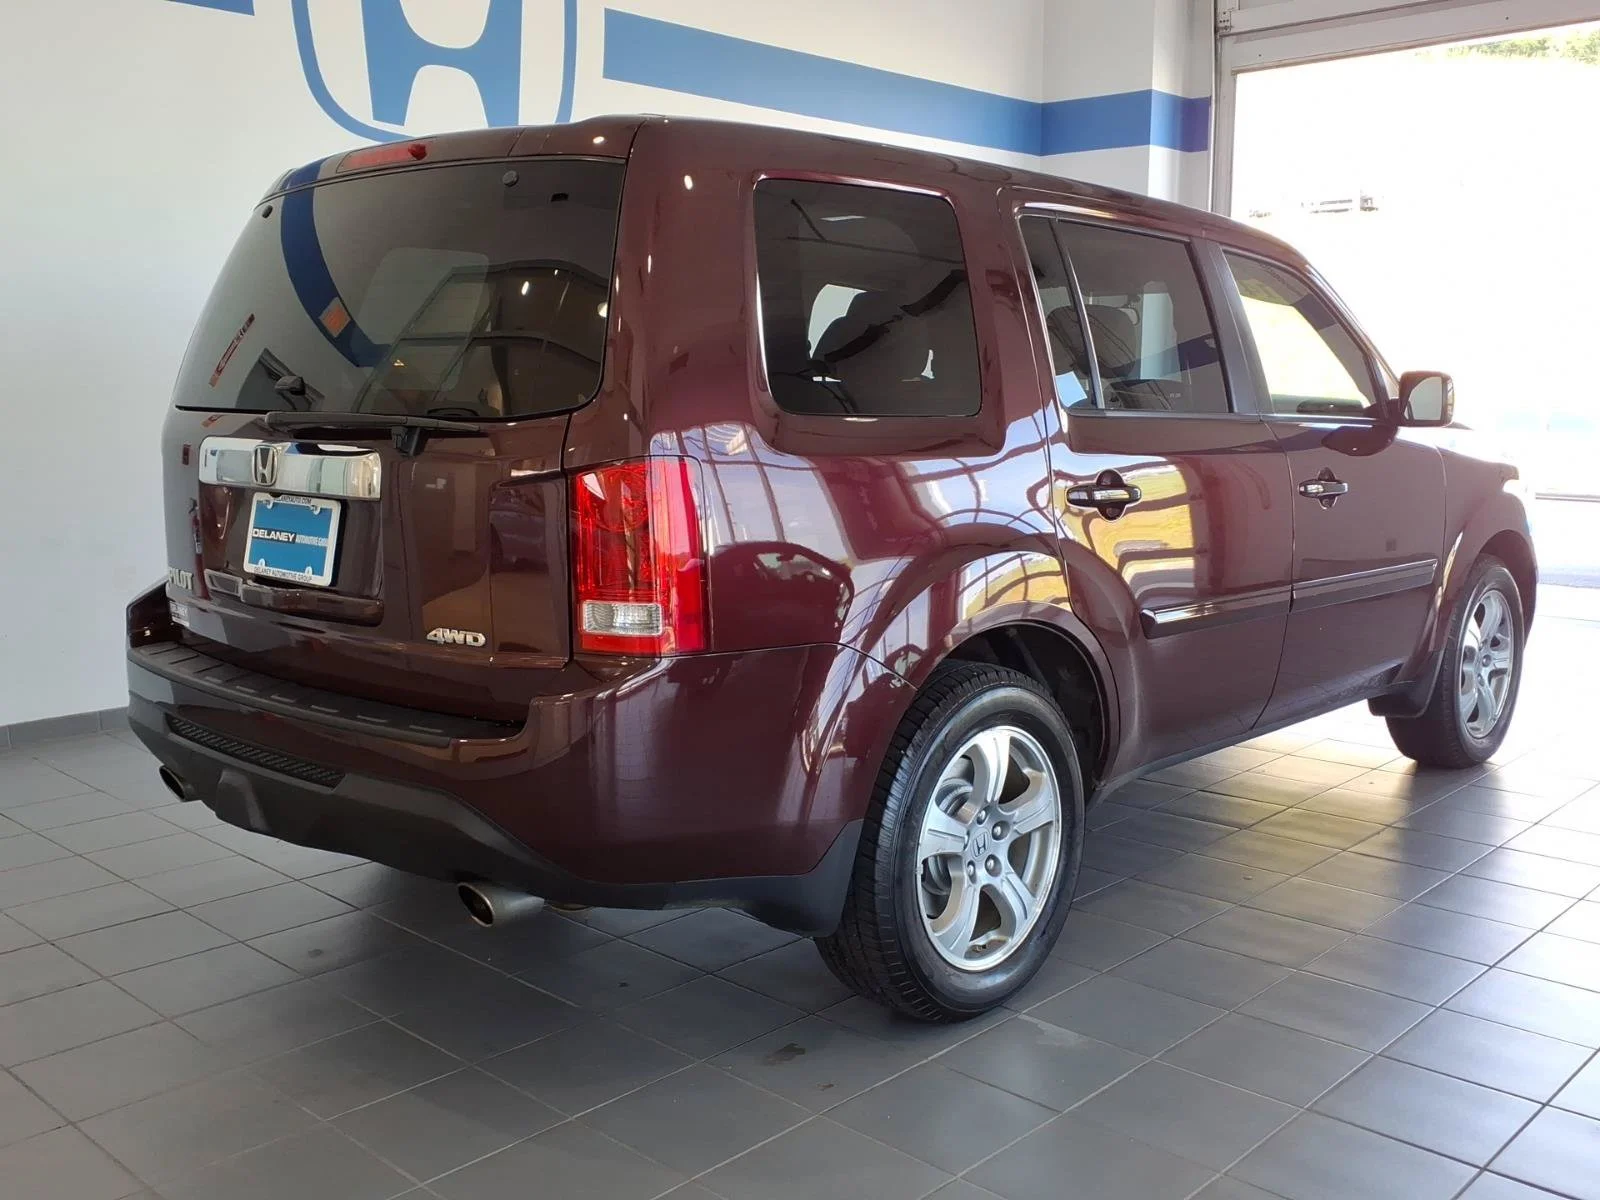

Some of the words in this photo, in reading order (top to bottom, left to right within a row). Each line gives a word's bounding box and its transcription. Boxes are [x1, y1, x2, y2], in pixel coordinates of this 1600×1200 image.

[253, 528, 295, 542] DELANEY
[167, 567, 193, 590] PILOT
[254, 566, 271, 576] DELANEY
[271, 569, 297, 580] AUTOMOTIVE
[297, 573, 312, 582] GROUP
[426, 627, 486, 647] 4WD
